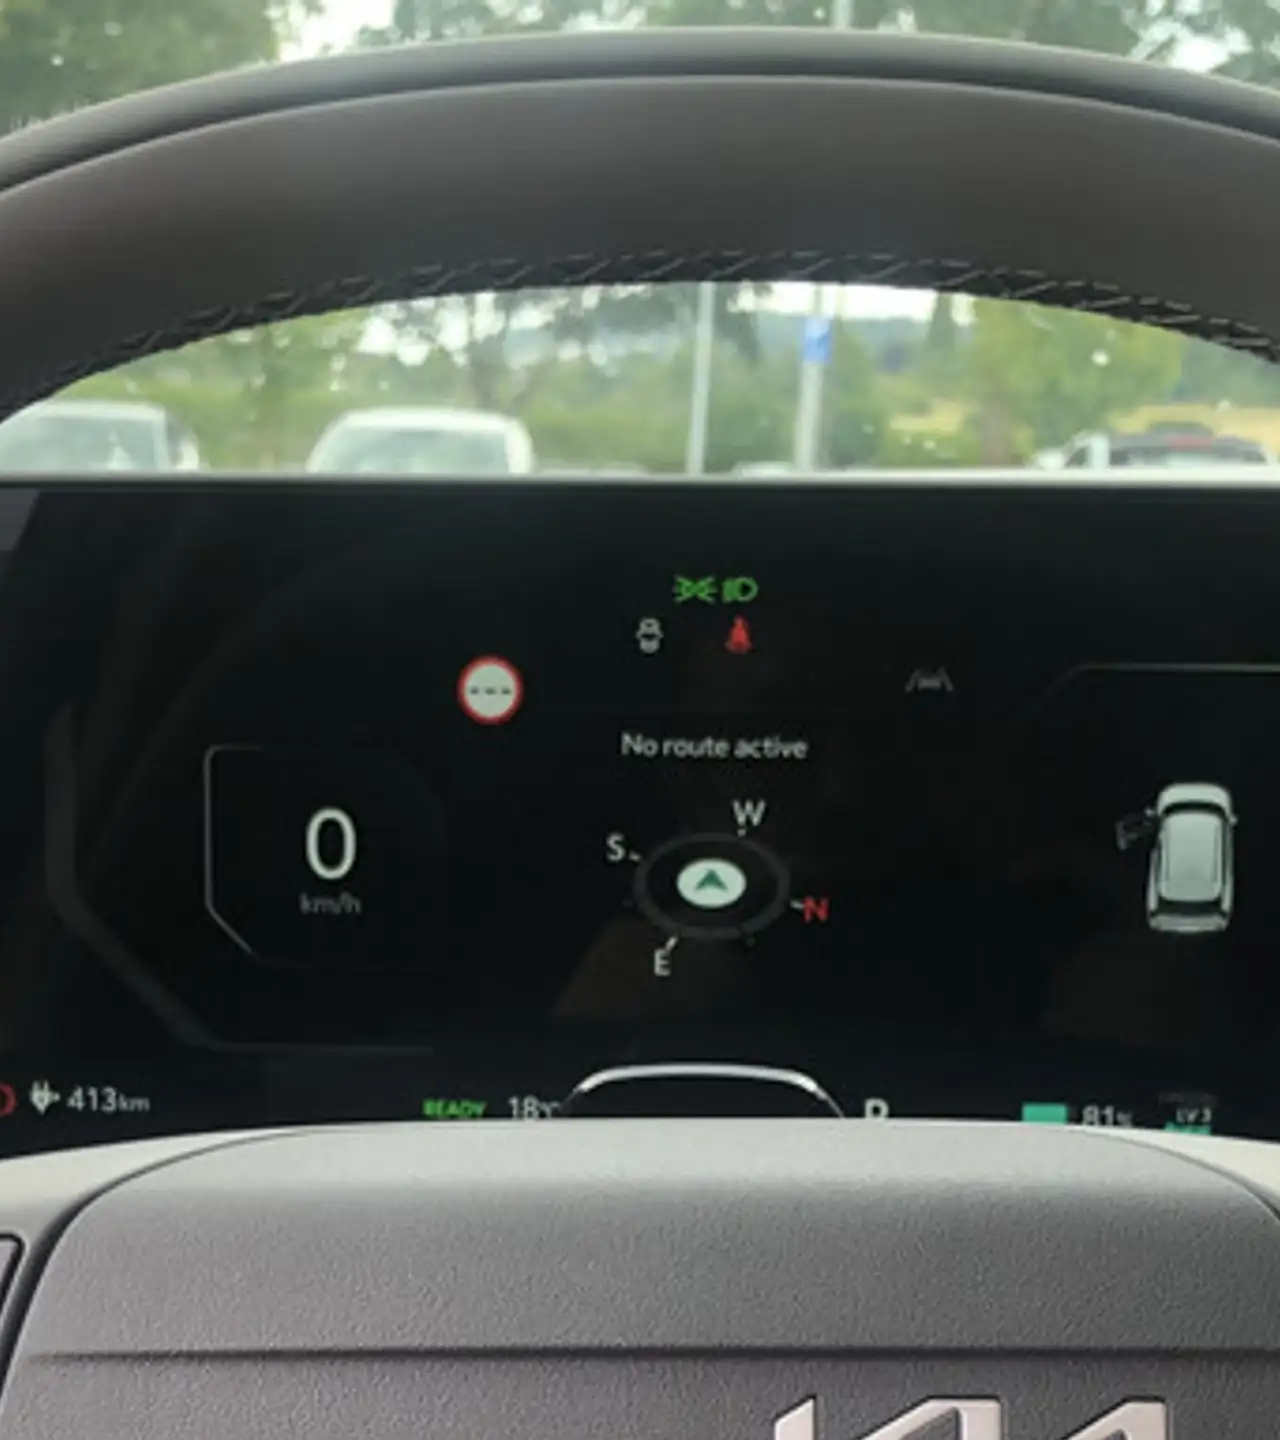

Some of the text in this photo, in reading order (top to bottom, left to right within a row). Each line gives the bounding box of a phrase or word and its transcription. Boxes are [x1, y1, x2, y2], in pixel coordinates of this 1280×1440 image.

[621, 732, 808, 760] No route active
[733, 798, 766, 826] W
[306, 807, 356, 879] 0
[606, 832, 625, 862] S
[300, 891, 362, 915] km/h
[803, 896, 829, 922] N
[653, 948, 672, 977] E
[422, 1097, 488, 1119] READY
